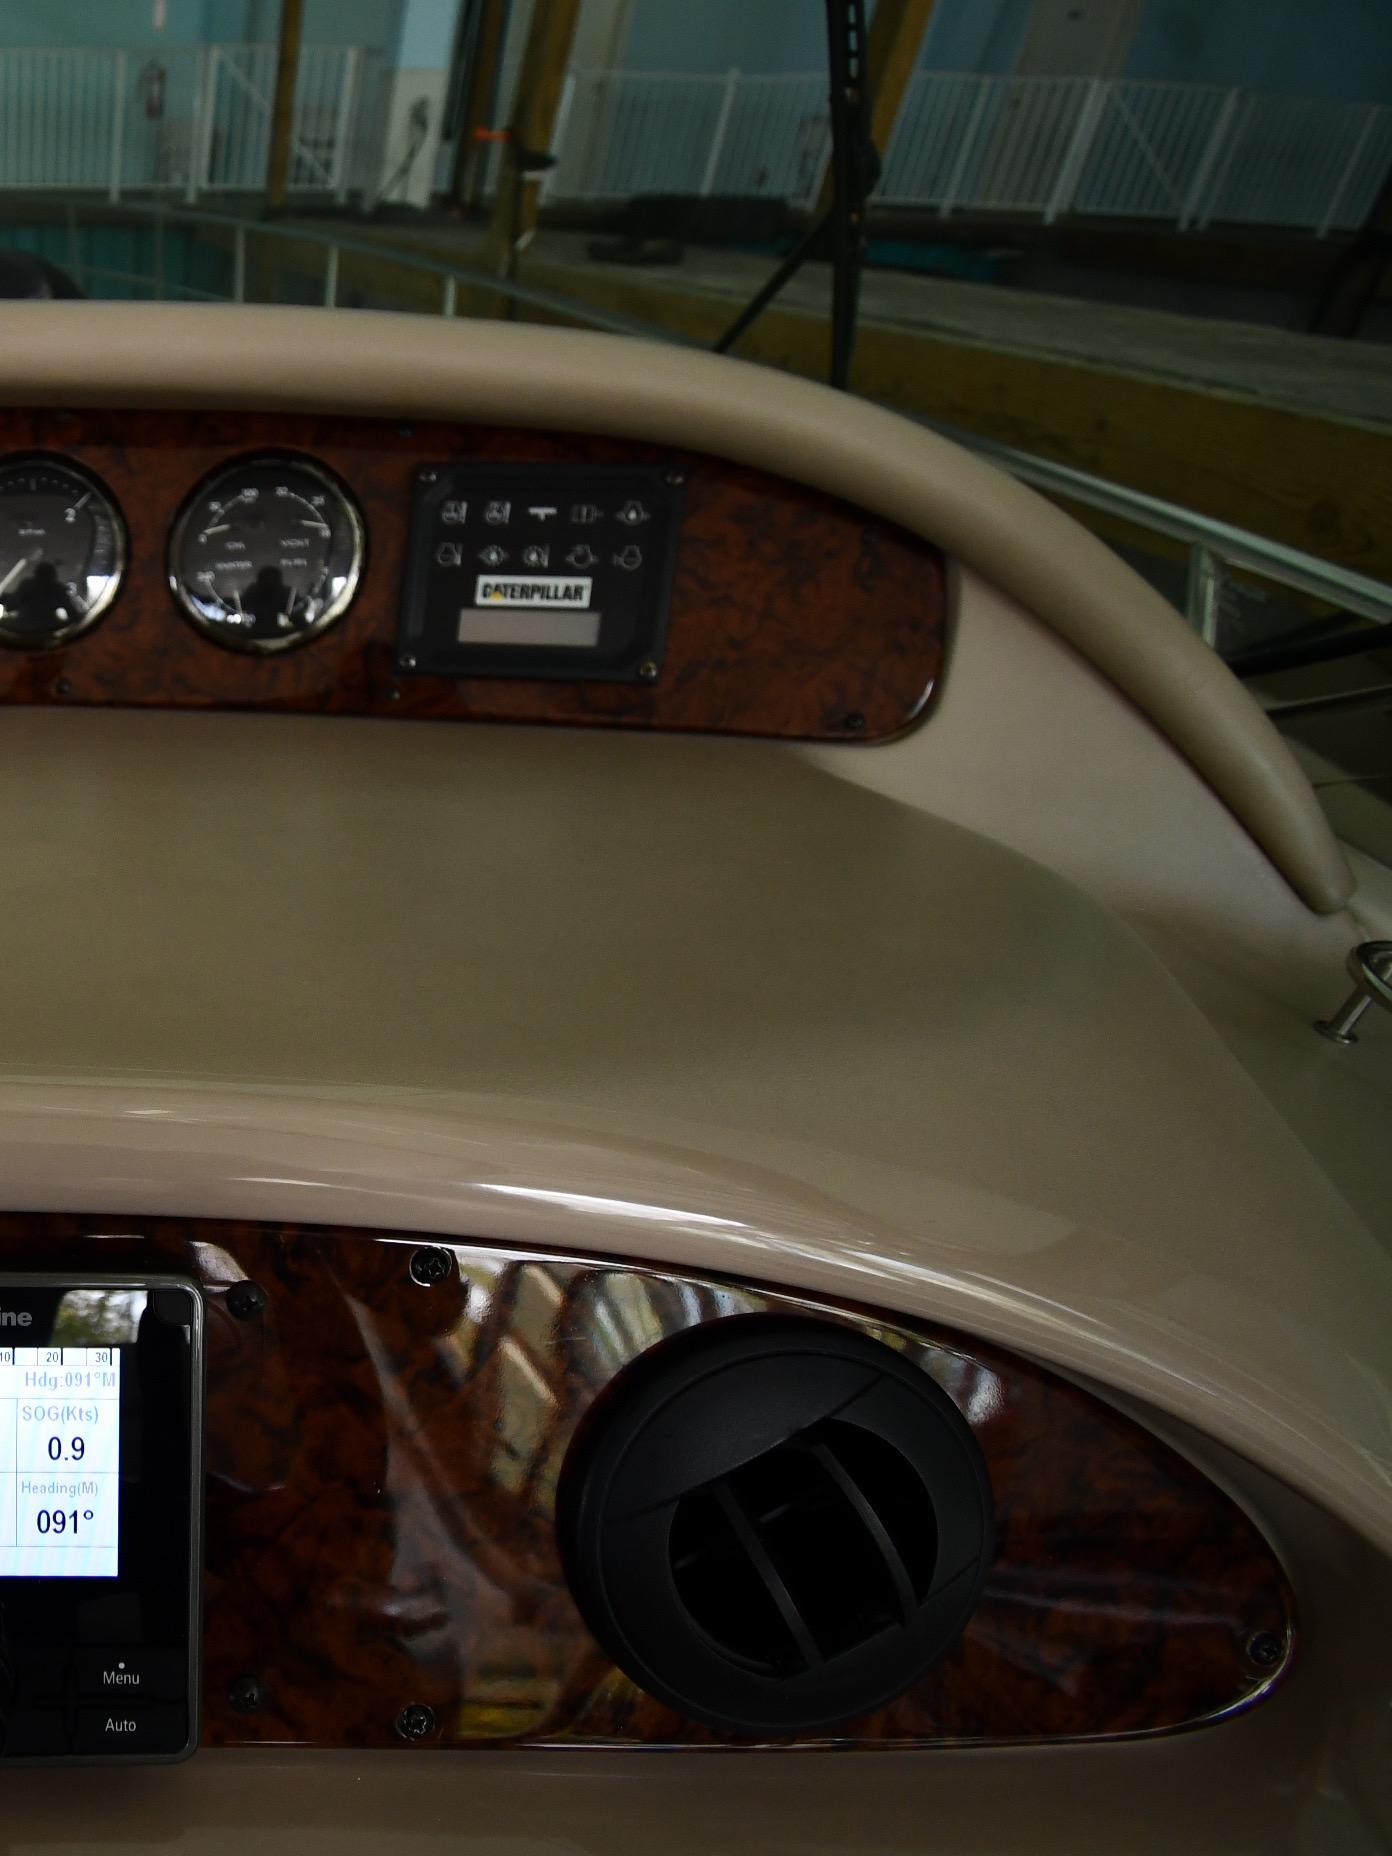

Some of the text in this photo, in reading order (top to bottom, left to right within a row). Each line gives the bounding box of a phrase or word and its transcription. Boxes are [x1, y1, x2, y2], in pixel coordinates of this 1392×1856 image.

[64, 507, 77, 523] 2
[482, 583, 585, 601] CATERPILLAR
[0, 1352, 11, 1363] 10
[46, 1352, 59, 1363] 20
[95, 1352, 108, 1363] 30
[22, 1405, 99, 1424] SOG(Kts)
[48, 1436, 85, 1461] 0.9
[22, 1481, 98, 1498] Heading(M)
[37, 1509, 94, 1534] 091°
[103, 1671, 140, 1685] Menu
[105, 1717, 137, 1732] Auto
